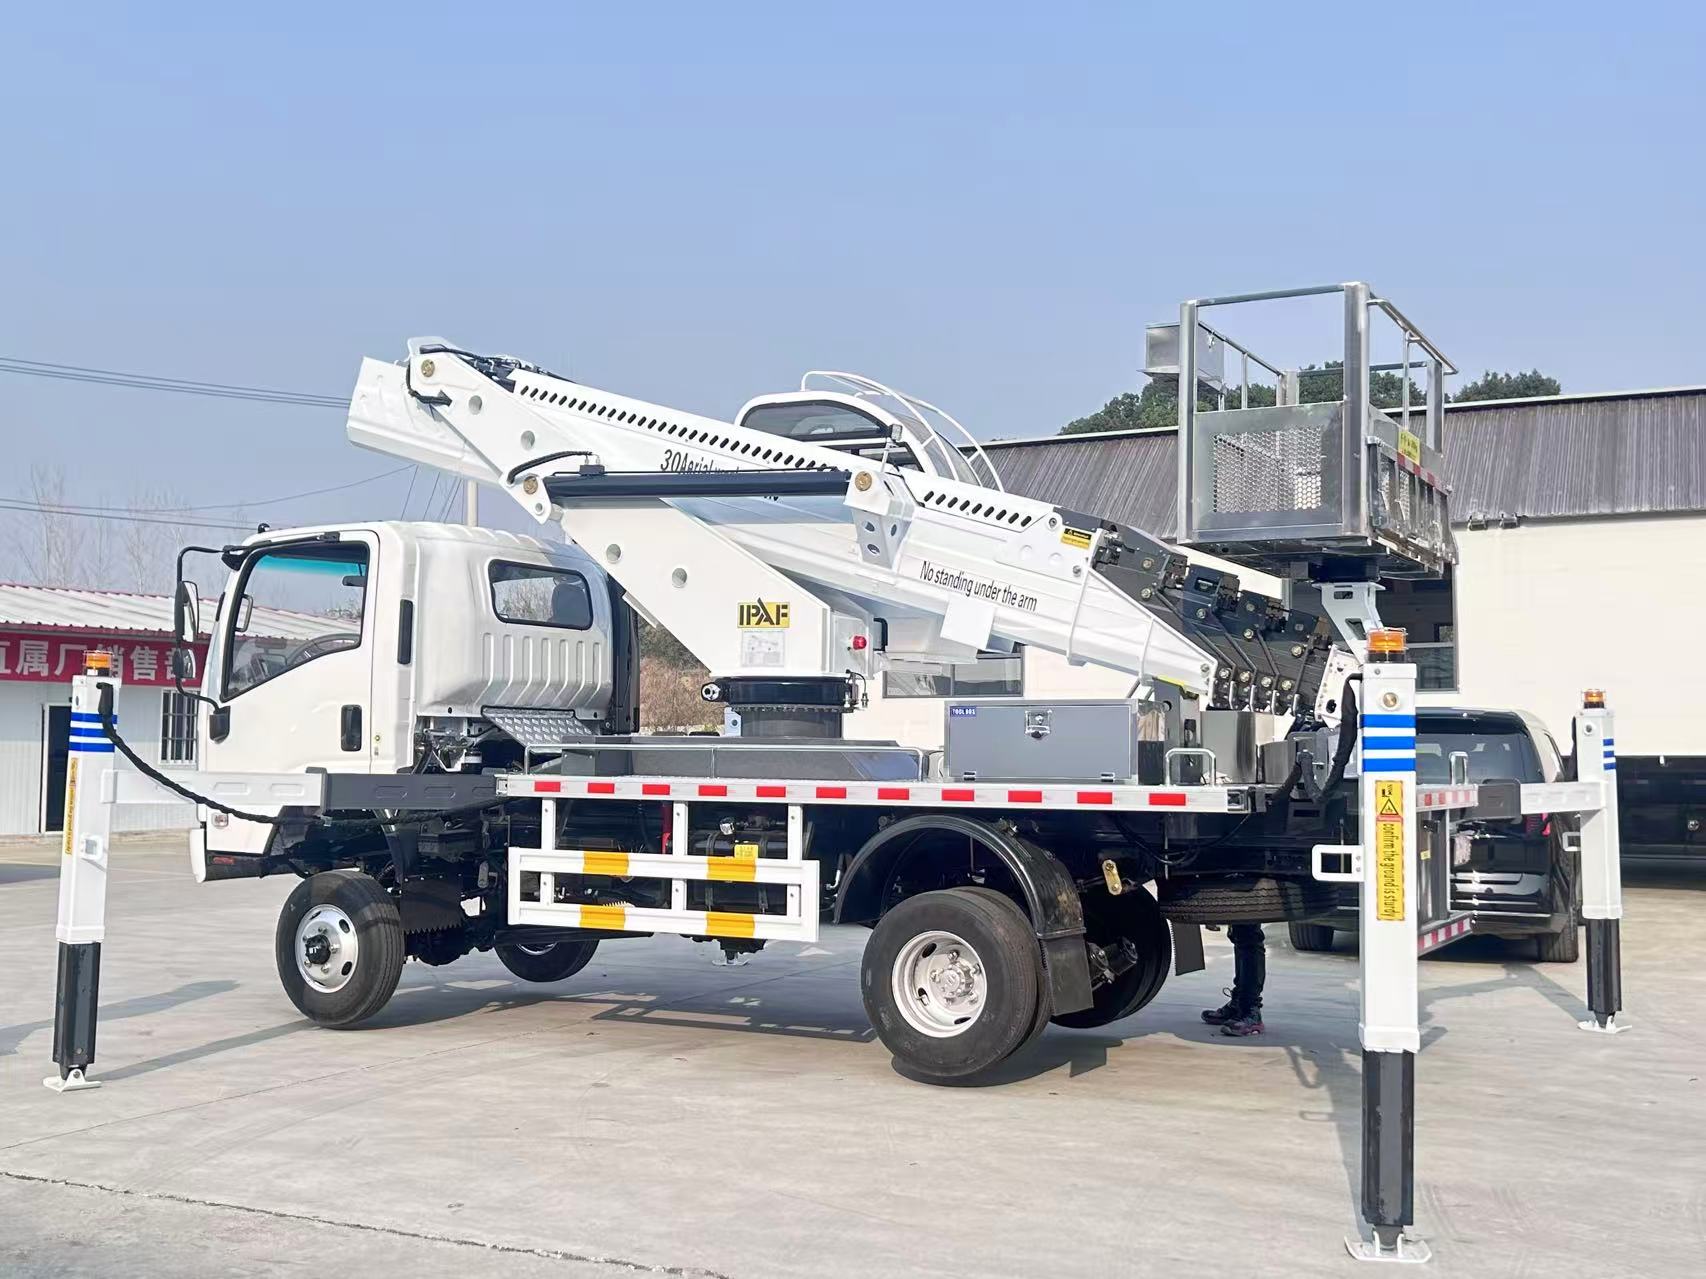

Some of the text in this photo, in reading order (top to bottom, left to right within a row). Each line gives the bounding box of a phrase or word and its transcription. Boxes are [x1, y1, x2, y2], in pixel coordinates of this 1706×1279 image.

[920, 561, 1038, 612] No standing under the arm
[739, 597, 788, 626] IPAF
[1383, 823, 1399, 849] confirm
[1383, 851, 1400, 861] the
[1380, 863, 1400, 887] ground
[1380, 895, 1401, 918] sturdy
